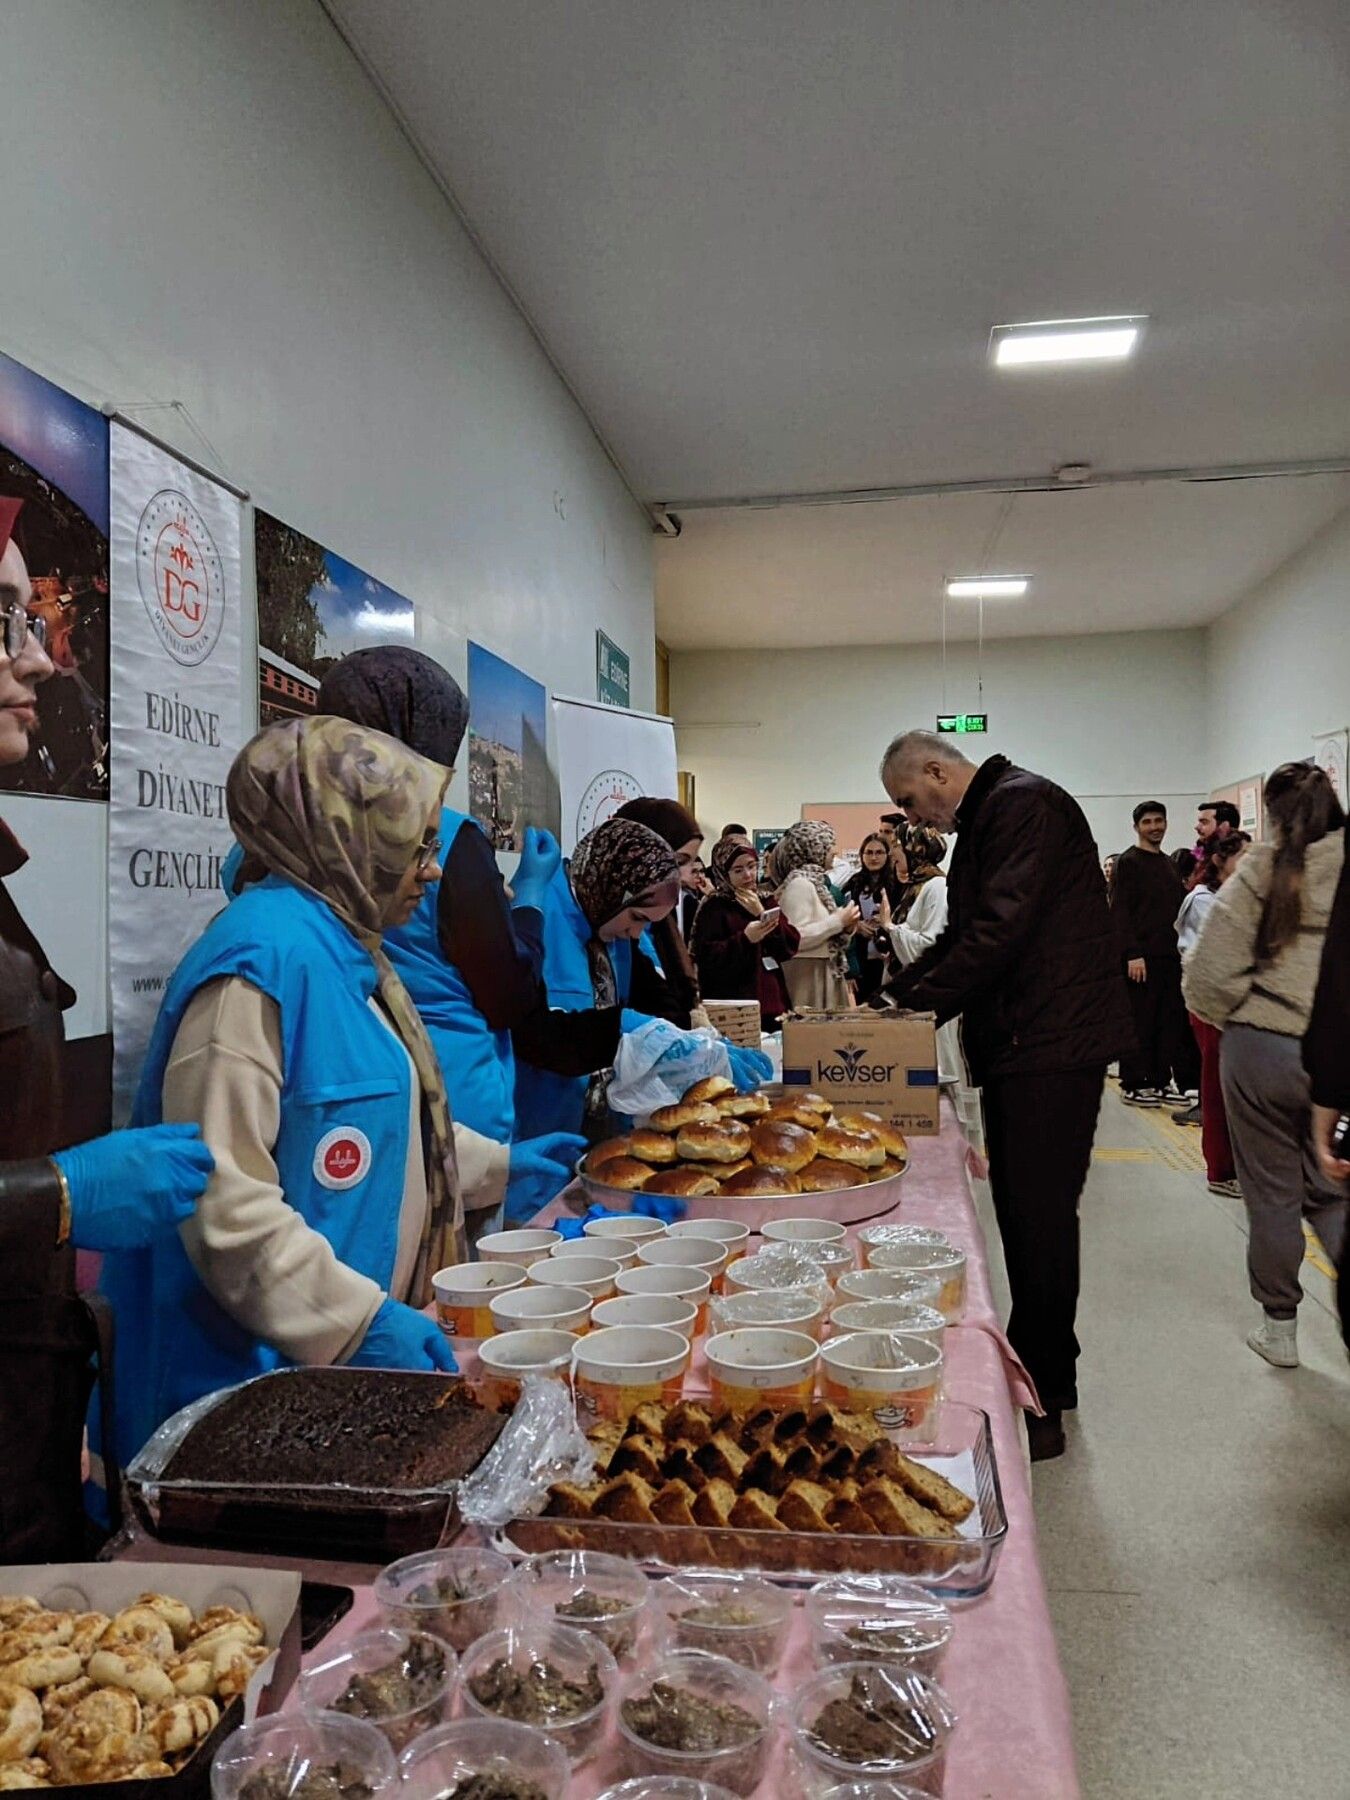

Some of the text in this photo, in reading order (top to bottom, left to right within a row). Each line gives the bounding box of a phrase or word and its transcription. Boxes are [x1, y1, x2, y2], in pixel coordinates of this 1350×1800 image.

[144, 692, 221, 748] EDİRNE
[136, 762, 226, 819] DİYANET
[817, 1059, 896, 1083] kevser
